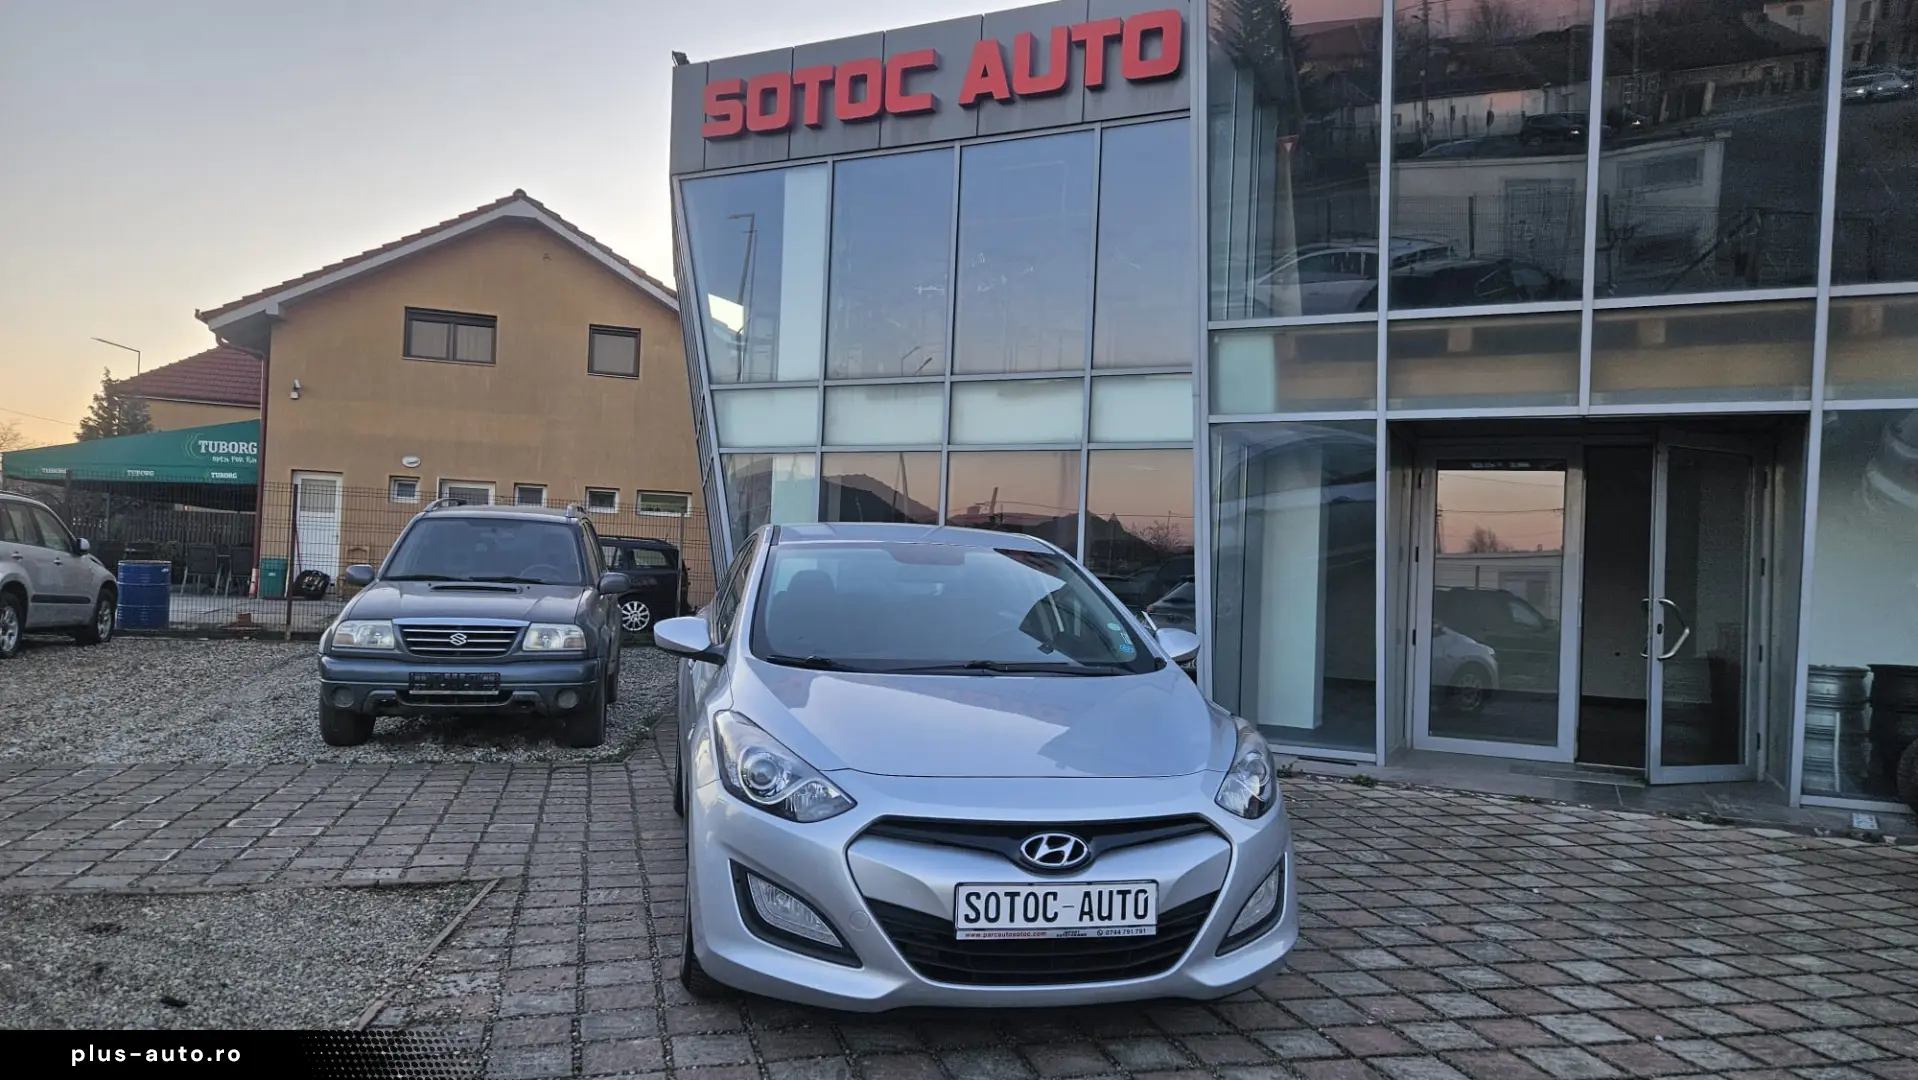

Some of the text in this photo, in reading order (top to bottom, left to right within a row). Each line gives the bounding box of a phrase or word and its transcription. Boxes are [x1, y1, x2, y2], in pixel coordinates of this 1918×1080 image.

[702, 9, 1183, 139] SOTOC AUTO
[198, 440, 258, 454] TUBORG
